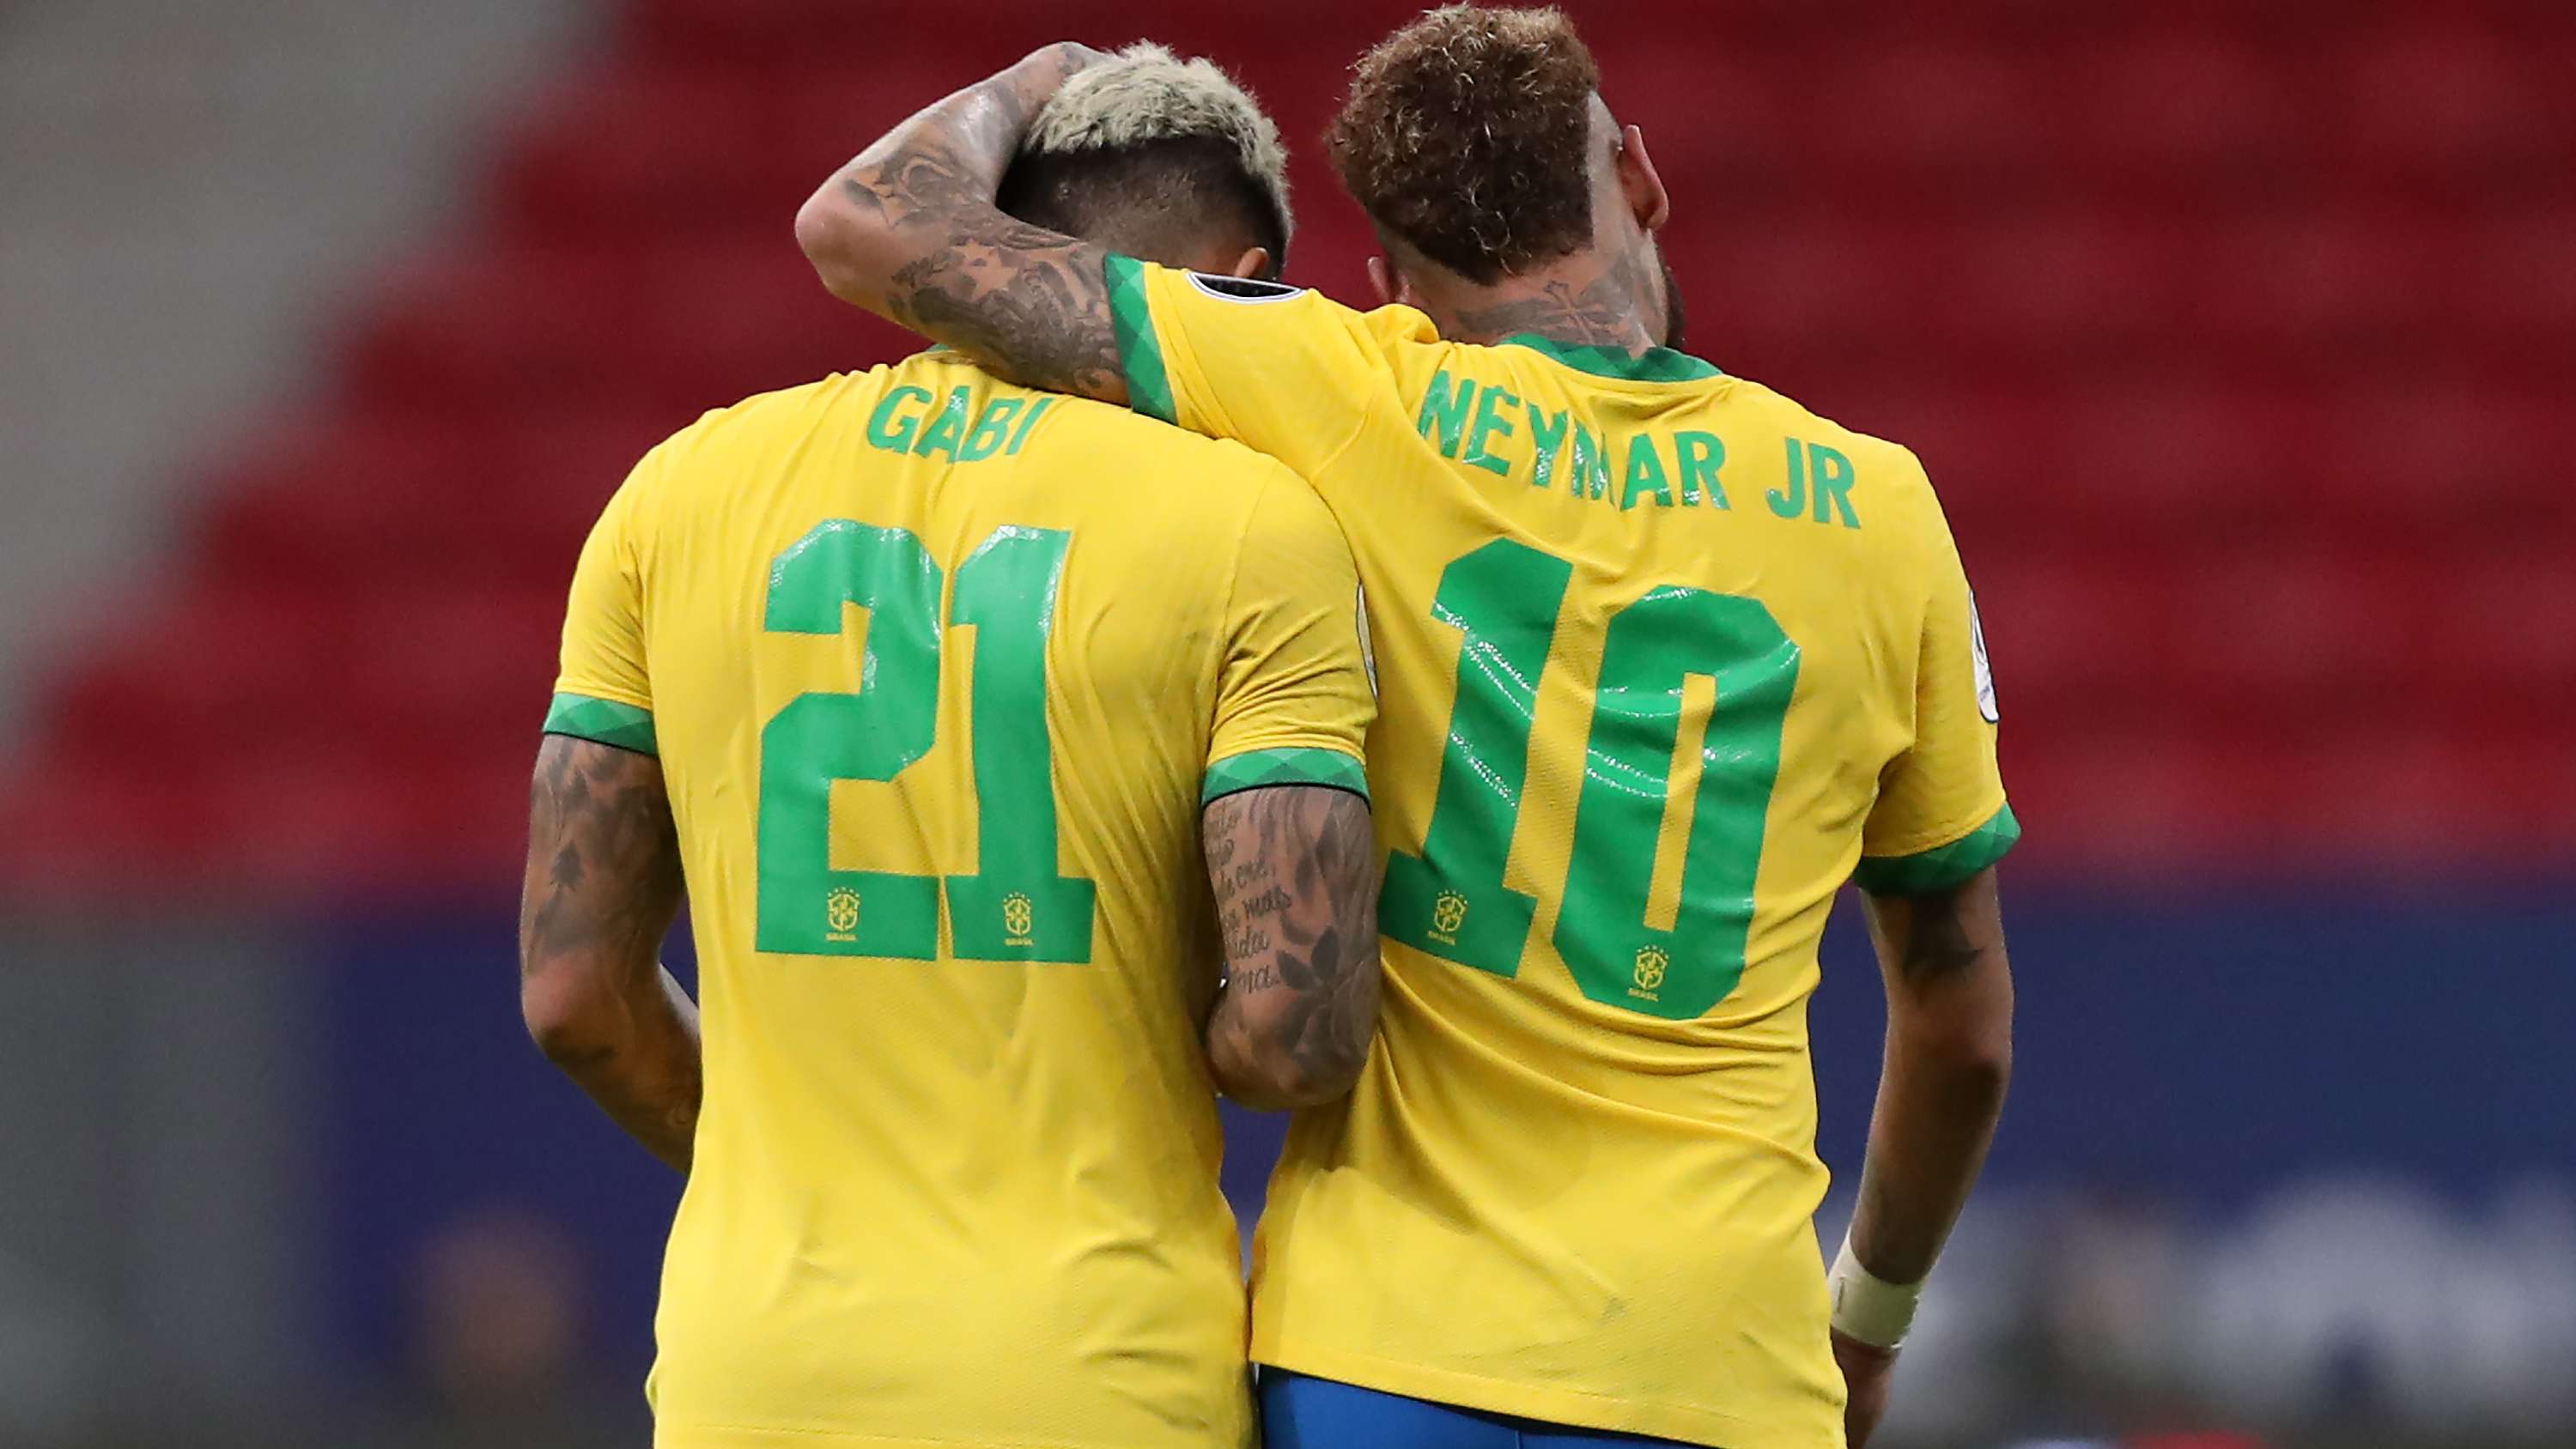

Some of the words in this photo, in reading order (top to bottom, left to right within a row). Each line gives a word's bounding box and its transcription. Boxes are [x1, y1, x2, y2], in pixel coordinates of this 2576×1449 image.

[867, 385, 1054, 464] GABI
[1418, 369, 1731, 512] NEYMAR
[1765, 435, 1861, 529] JR
[756, 518, 1097, 963] 21
[1377, 537, 1800, 1020] 10
